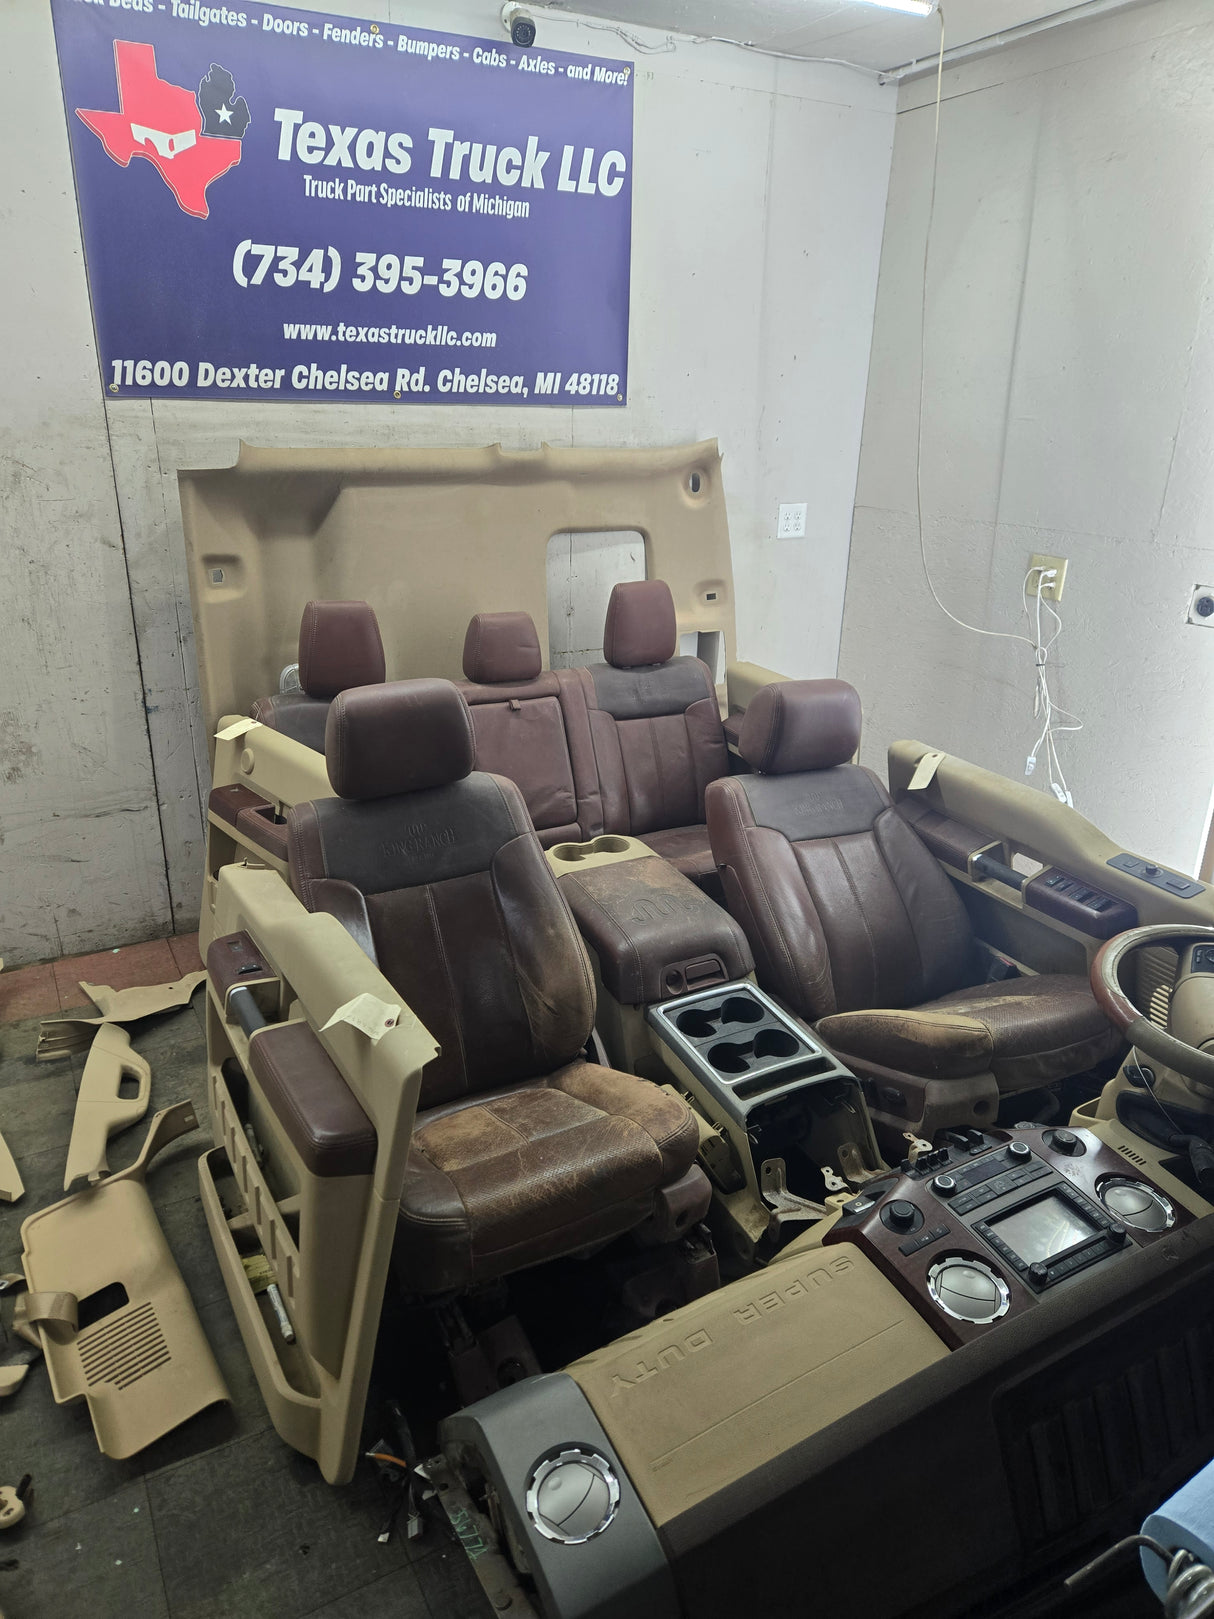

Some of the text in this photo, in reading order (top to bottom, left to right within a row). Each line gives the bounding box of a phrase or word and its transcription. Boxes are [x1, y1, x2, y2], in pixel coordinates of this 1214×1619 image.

[171, 0, 247, 26] Tailgates
[262, 13, 309, 37] Doors
[323, 23, 384, 48] Fenders
[397, 35, 460, 61] Bumpers
[473, 47, 507, 67] Cabs
[518, 55, 556, 75] Axles
[567, 64, 592, 80] and
[594, 66, 629, 86] More!
[273, 107, 627, 197] Texas Truck LLC
[303, 174, 530, 219] Truck Part Specialists of Michigan
[232, 239, 529, 301] (734) 395-3966
[283, 322, 497, 348] www.texastruckllc.com
[111, 359, 620, 398] 11600 Dexter Chelsea Rd. Chelsea, MI 48118
[608, 1254, 855, 1399] SUPER DUTY
